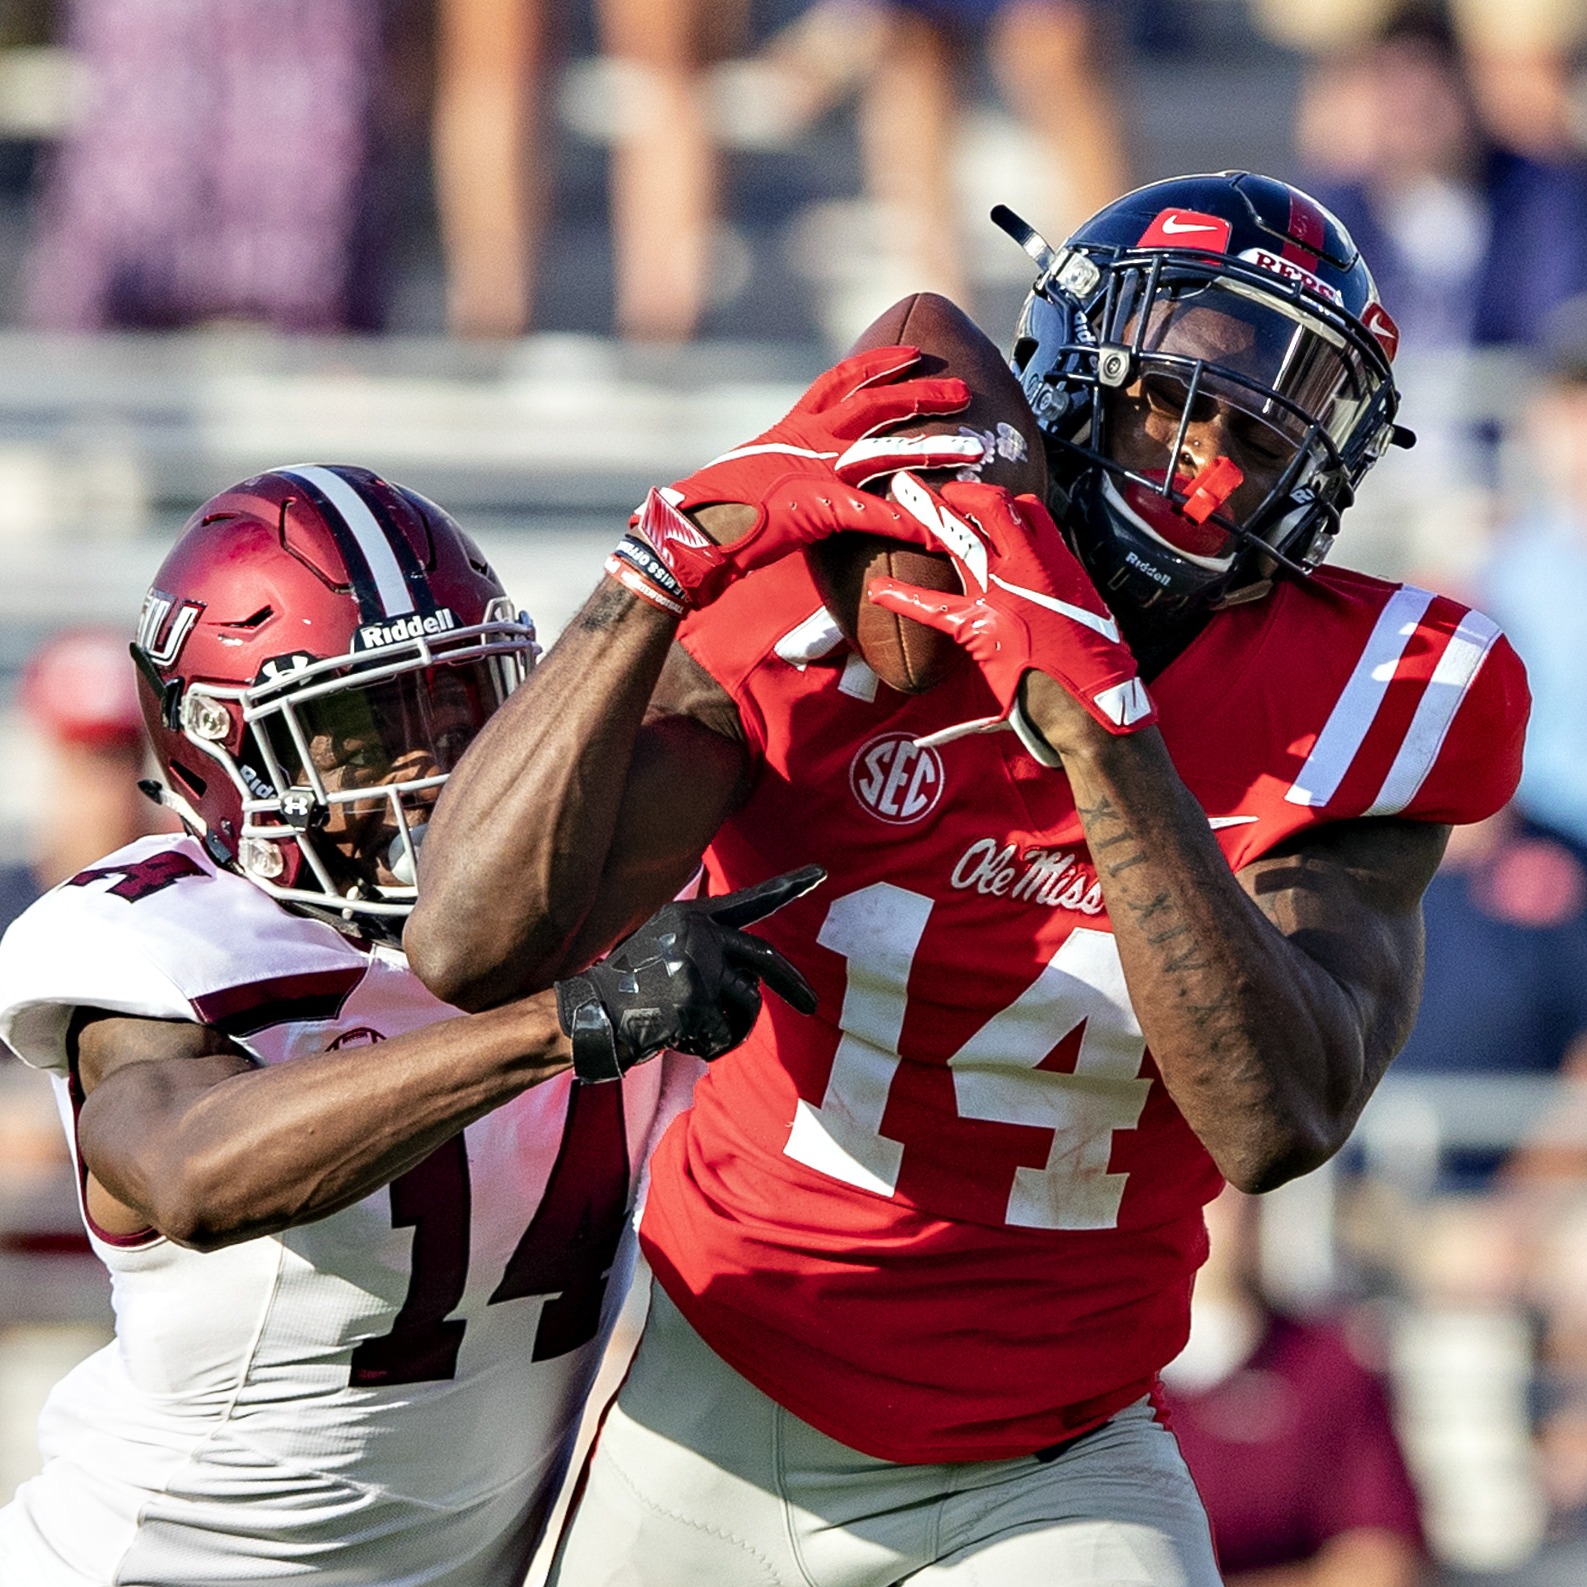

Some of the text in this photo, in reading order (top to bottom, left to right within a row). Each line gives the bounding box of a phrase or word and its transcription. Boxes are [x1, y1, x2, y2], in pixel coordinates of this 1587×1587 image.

[647, 561, 677, 590] MISS
[1124, 551, 1172, 587] Riddell
[361, 607, 455, 650] Riddell
[859, 740, 936, 818] SEC
[950, 837, 1105, 915] Ole Miss
[783, 881, 1154, 1231] 14
